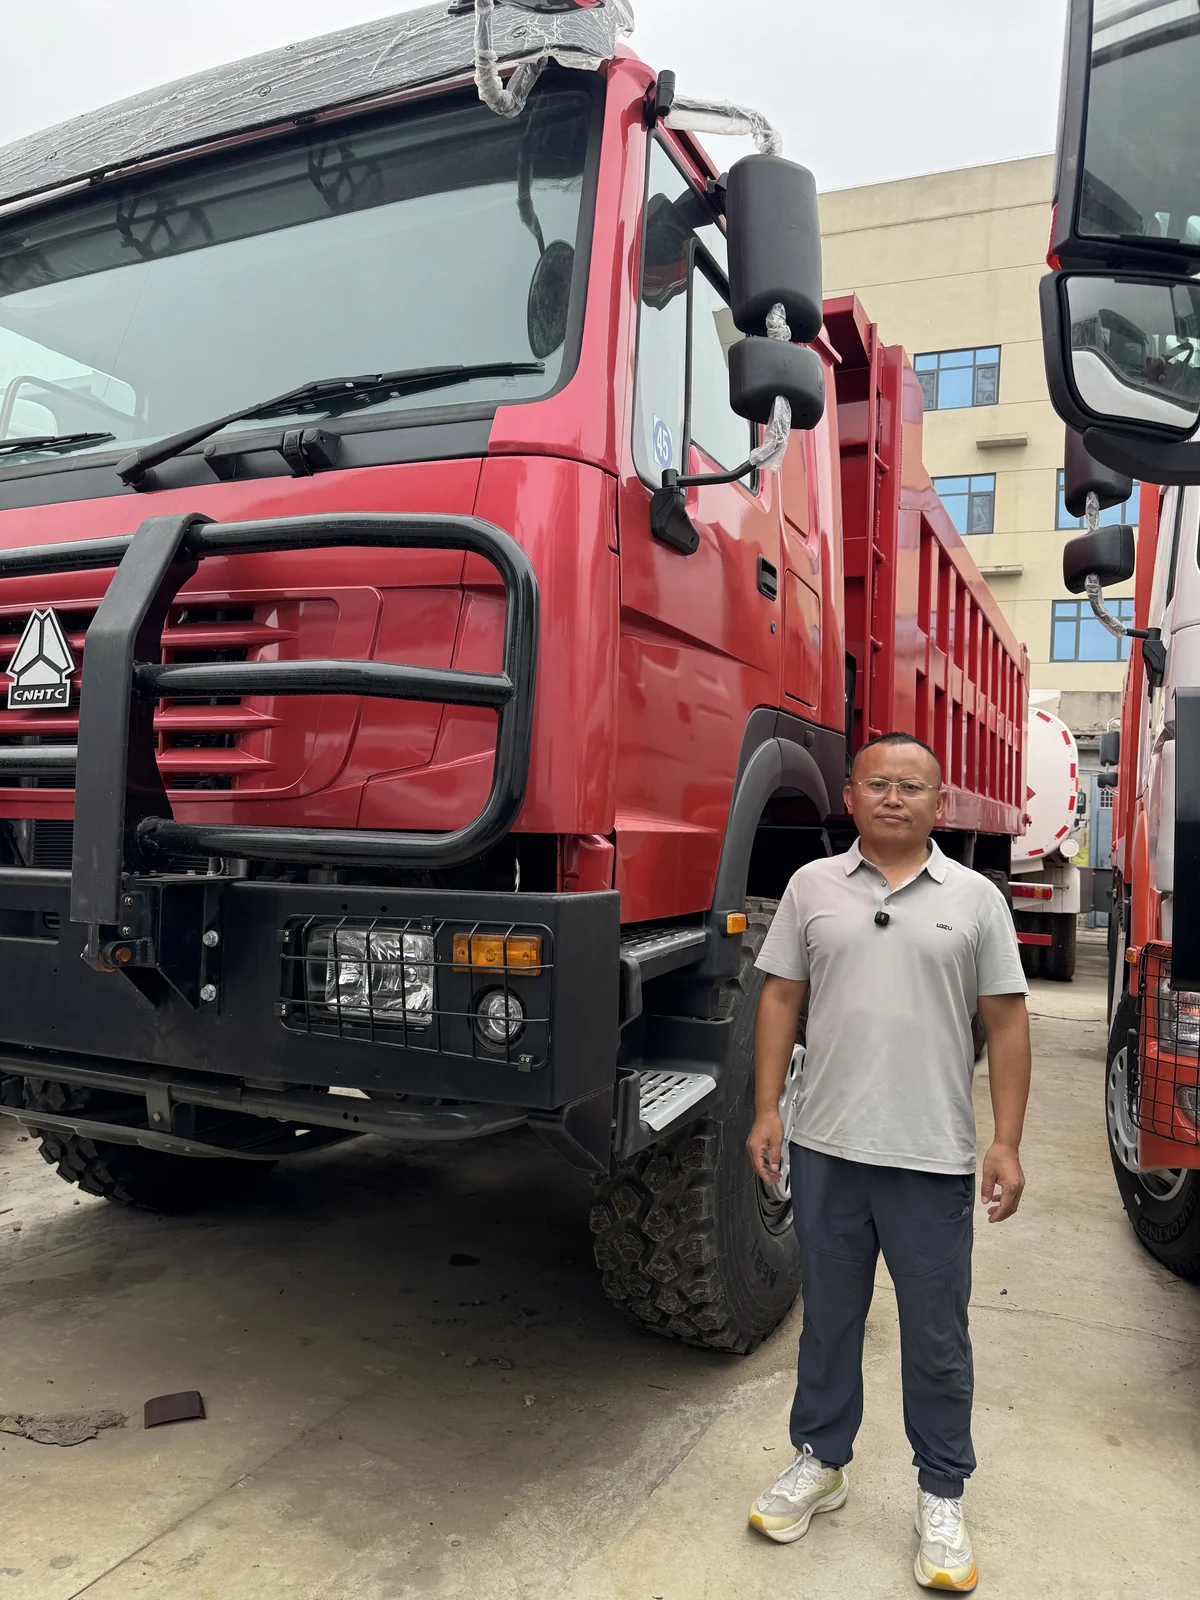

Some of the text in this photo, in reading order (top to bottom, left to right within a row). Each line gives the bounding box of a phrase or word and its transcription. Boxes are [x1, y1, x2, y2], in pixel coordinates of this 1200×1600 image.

[656, 426, 669, 462] 45
[13, 688, 65, 701] CNHTC
[1140, 1190, 1196, 1240] EUROKING
